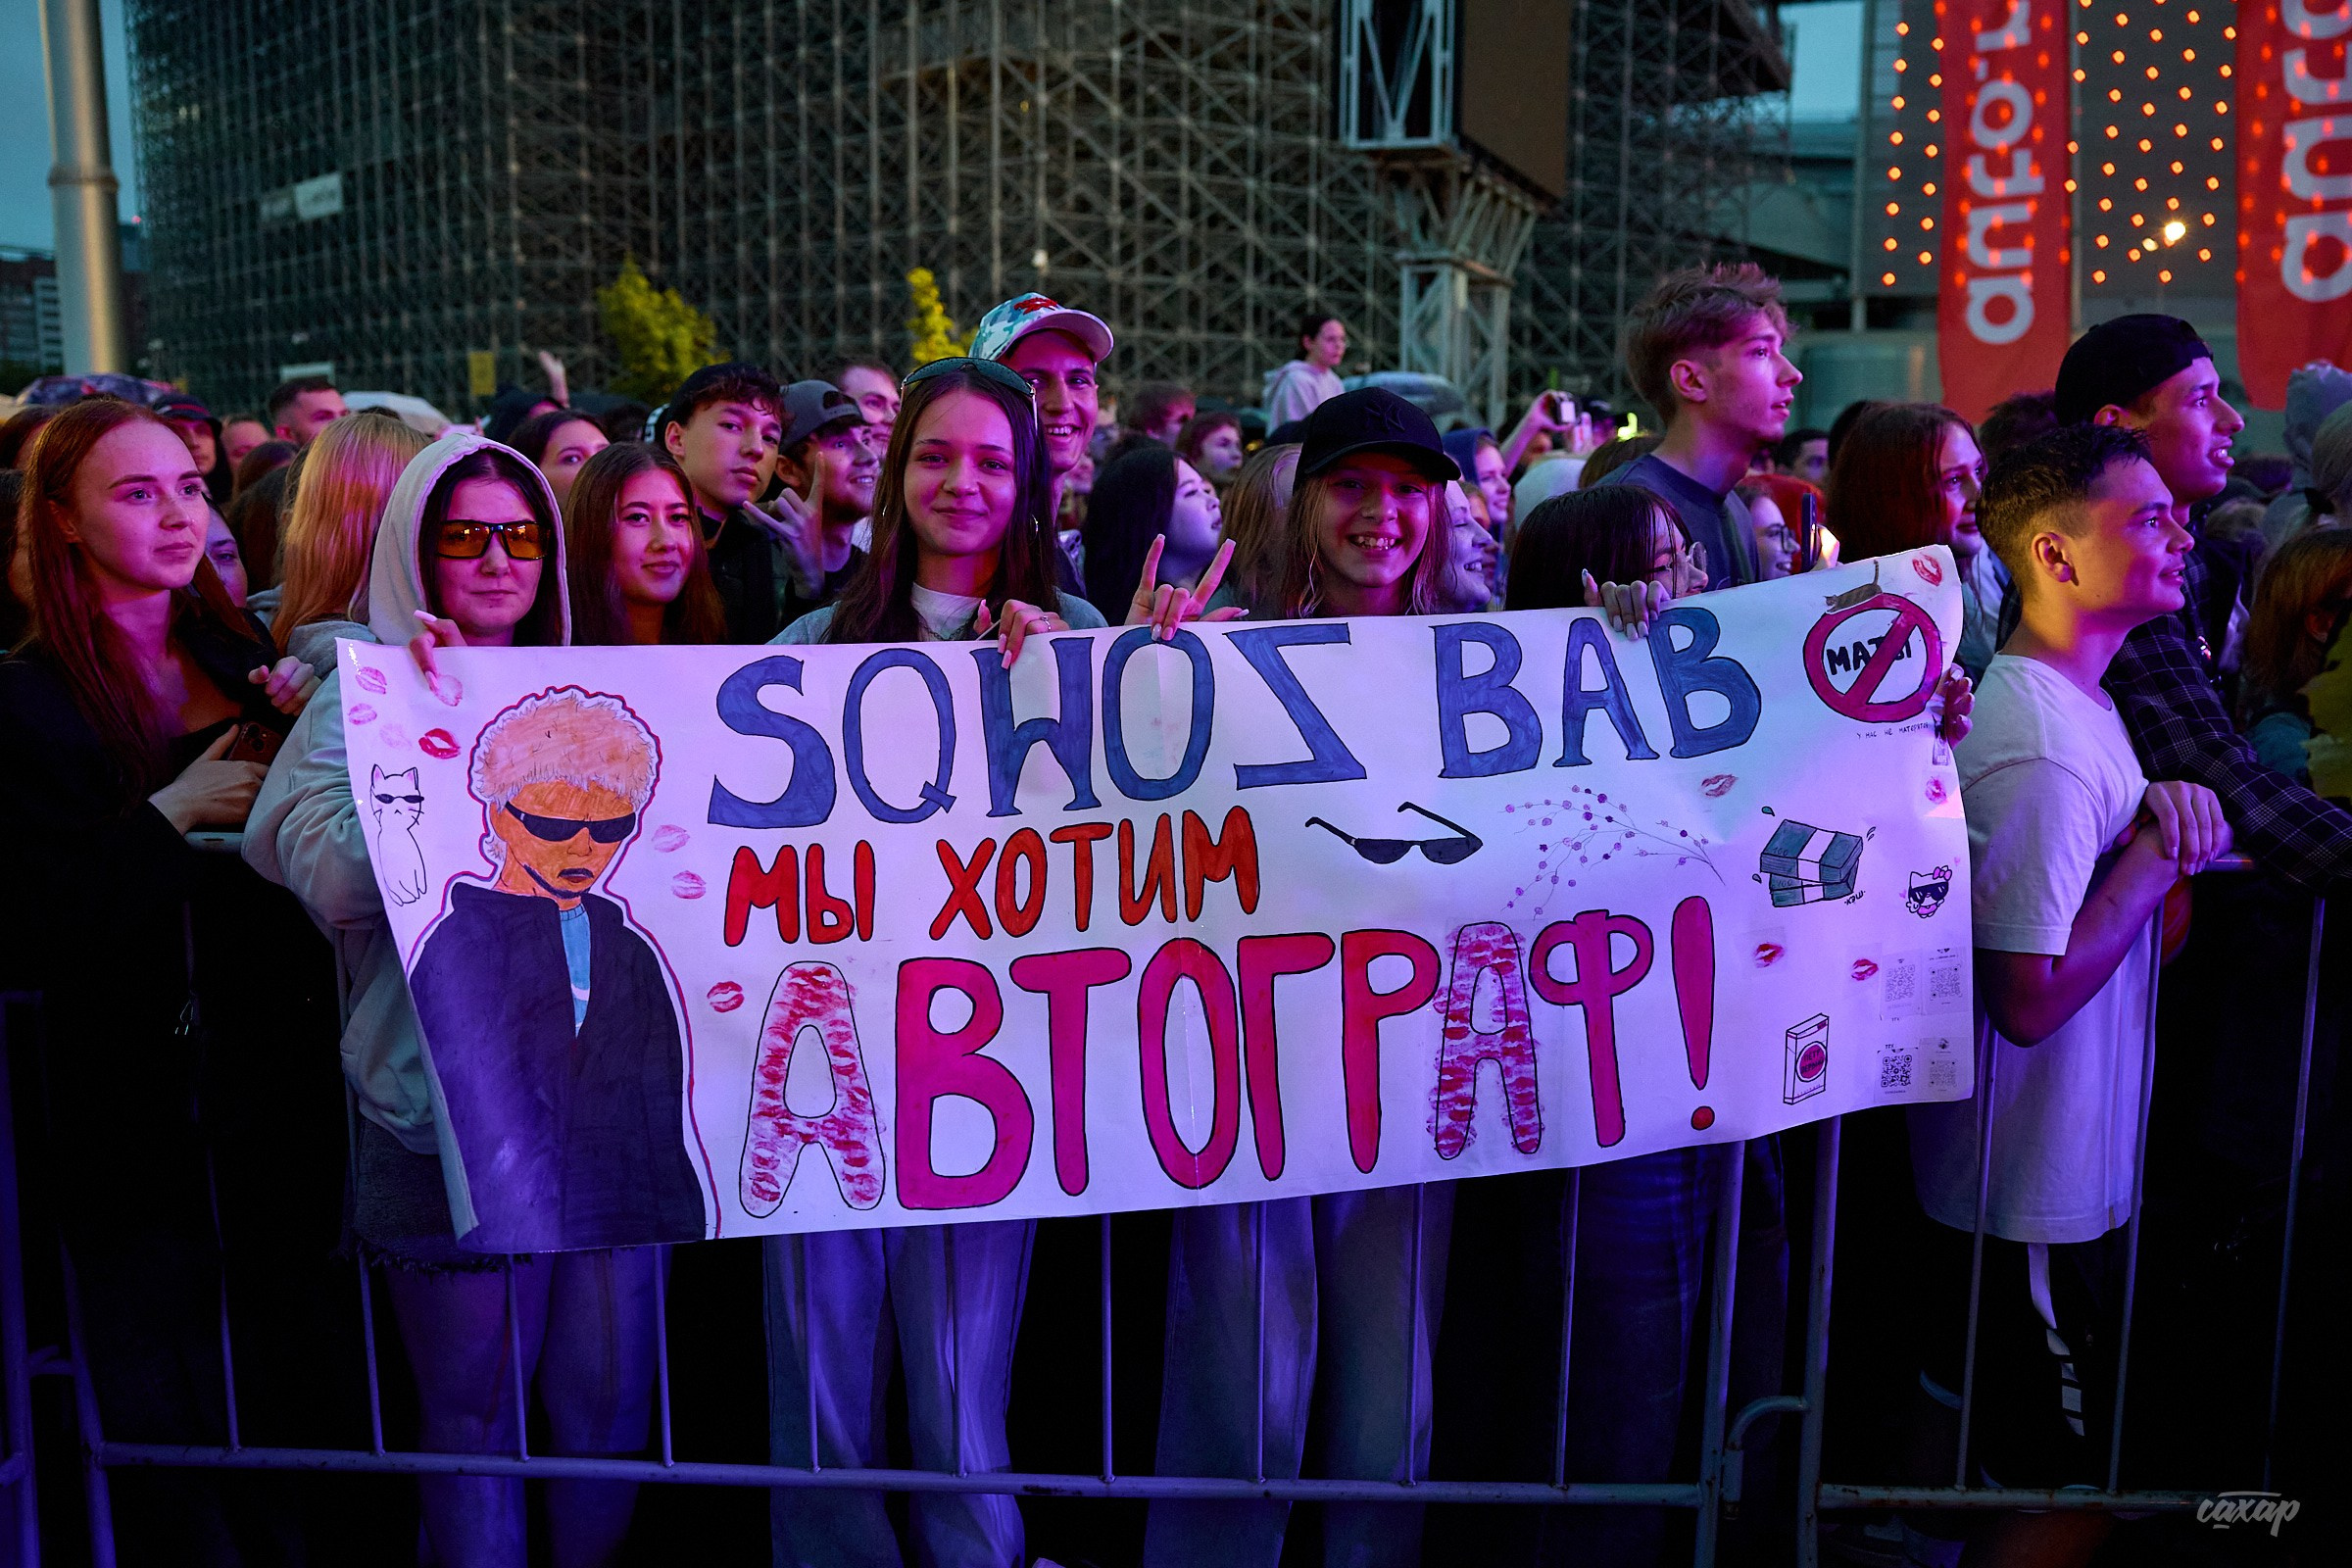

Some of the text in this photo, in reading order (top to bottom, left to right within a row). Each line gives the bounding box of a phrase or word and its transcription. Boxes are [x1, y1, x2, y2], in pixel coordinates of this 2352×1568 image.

[707, 607, 1762, 829] SQWOZ BAB
[723, 806, 1261, 947] МЫ ХОТИМ
[738, 895, 1717, 1218] АВТОГРАФ!
